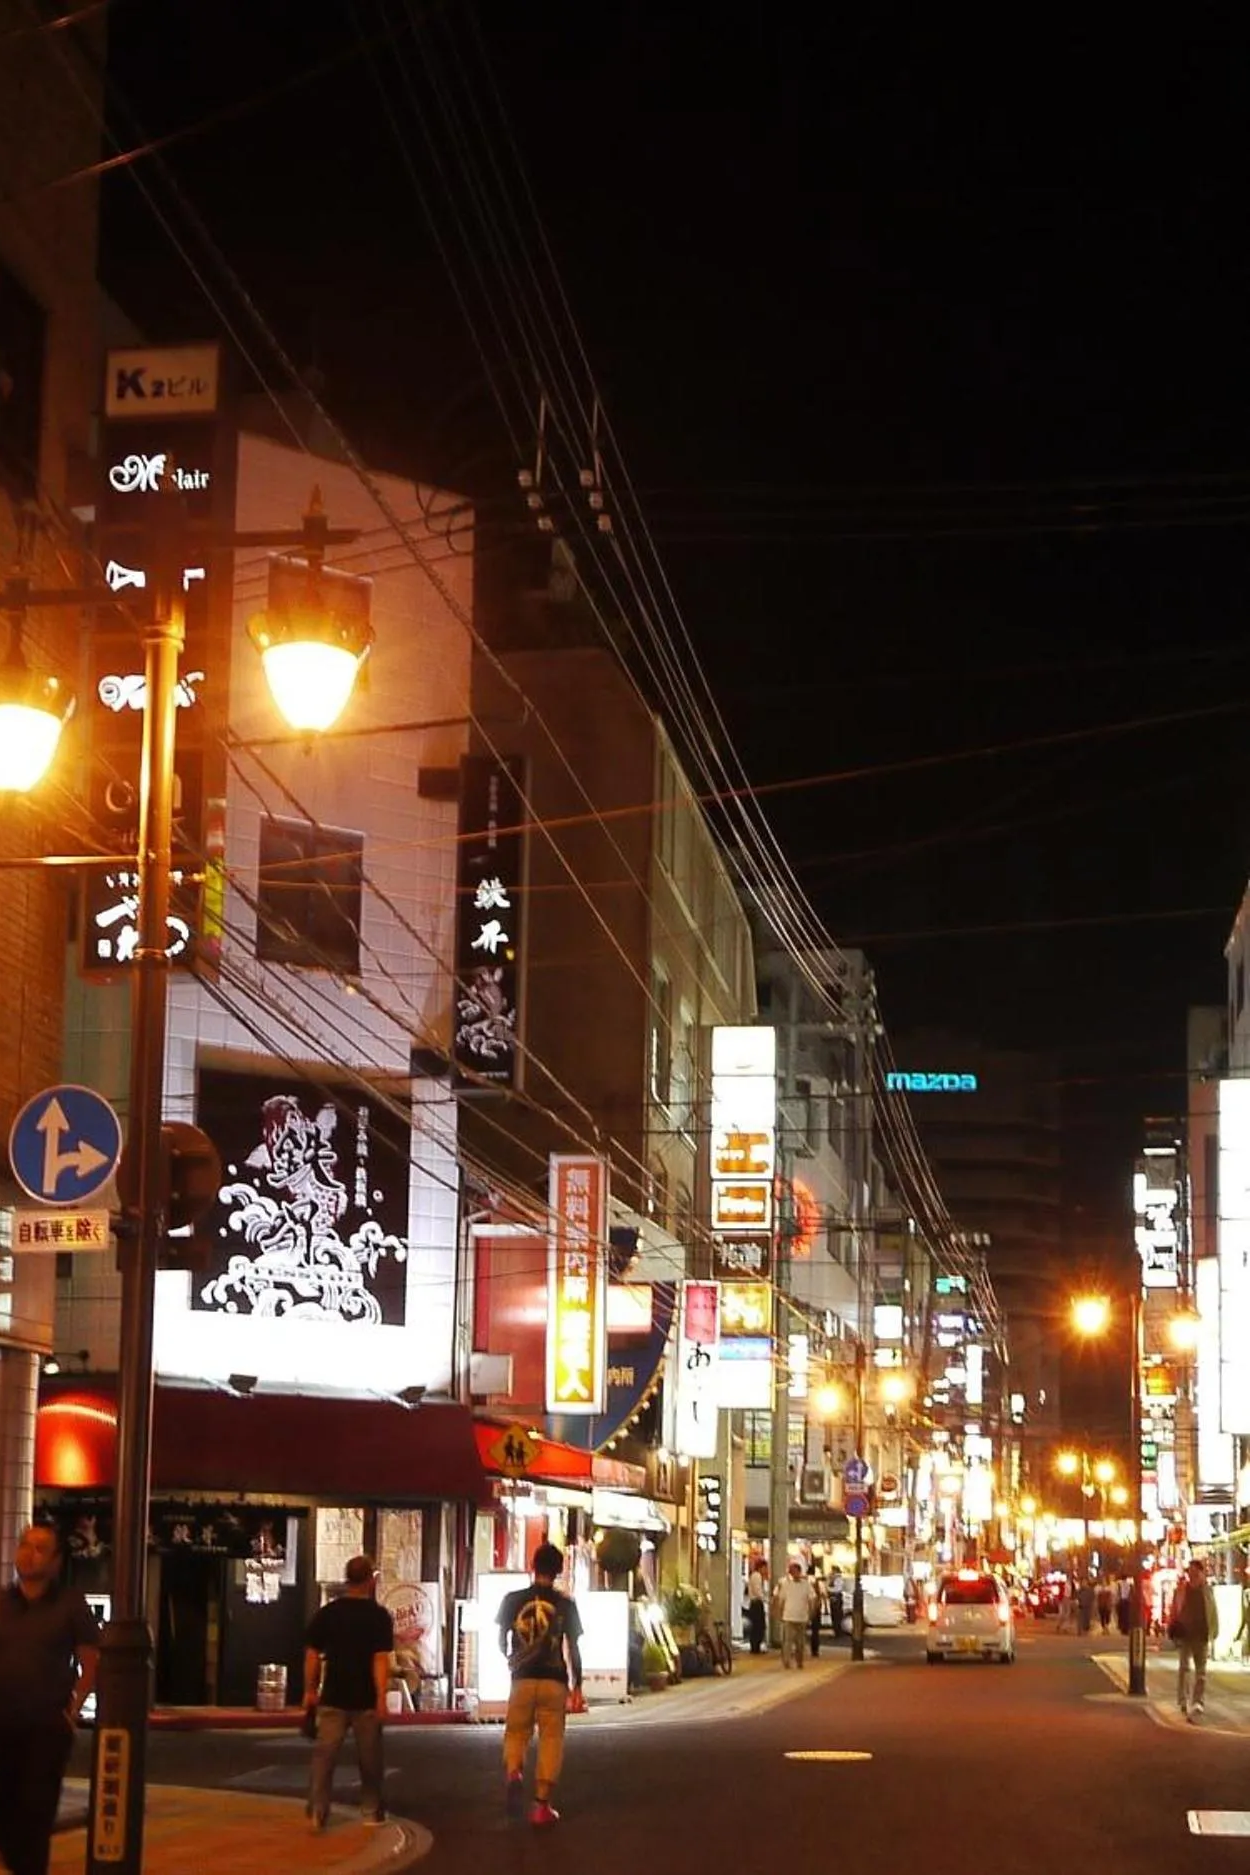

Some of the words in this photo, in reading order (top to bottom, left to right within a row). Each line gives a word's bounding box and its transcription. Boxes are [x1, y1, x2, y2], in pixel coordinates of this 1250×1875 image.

[19, 1217, 104, 1245] 自転車を除く
